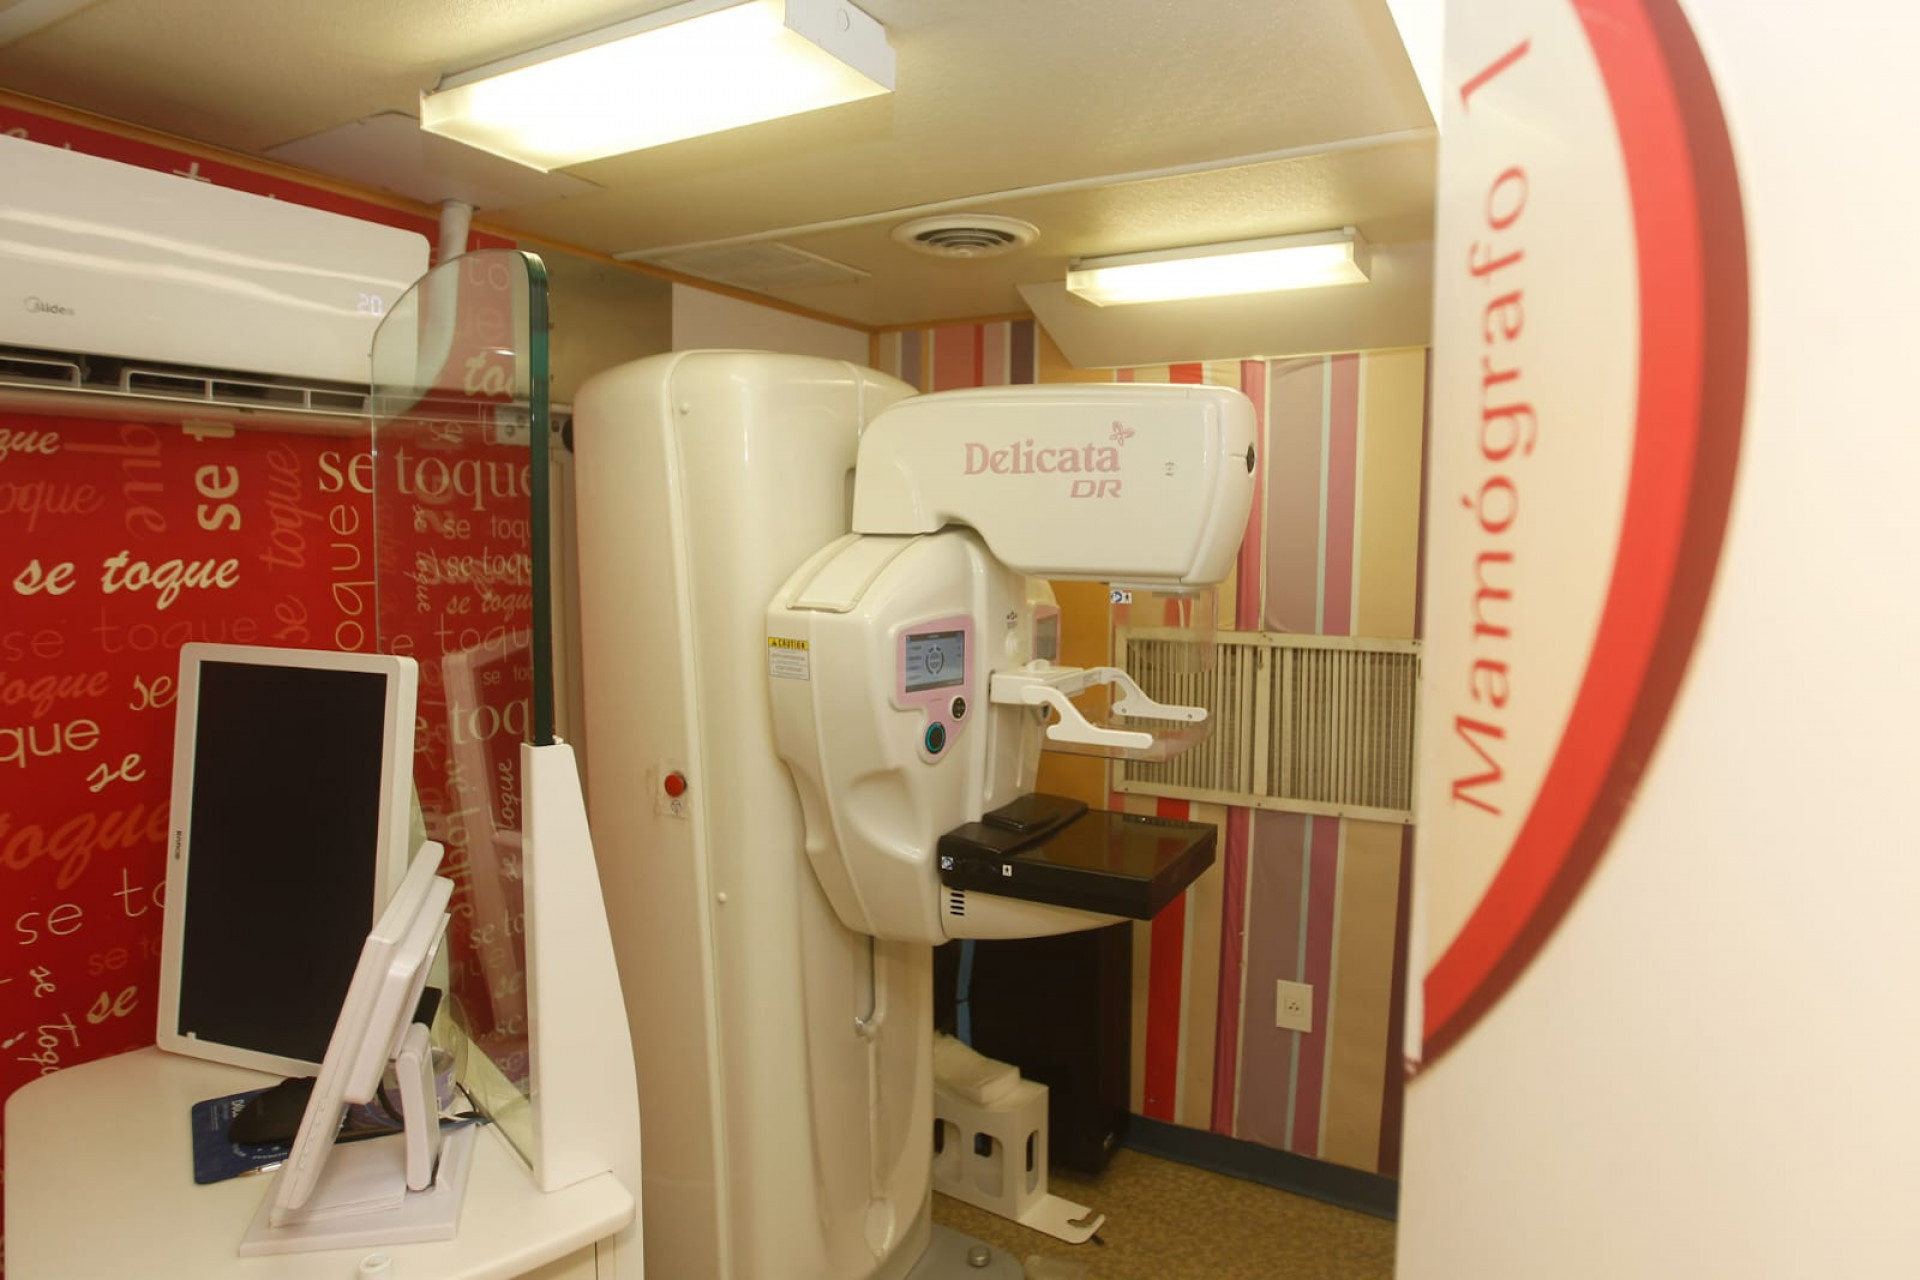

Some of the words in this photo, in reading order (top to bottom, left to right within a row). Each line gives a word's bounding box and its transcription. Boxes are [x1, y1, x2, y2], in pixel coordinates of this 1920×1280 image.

[318, 451, 373, 494] se
[963, 438, 1121, 476] Delicata
[194, 464, 242, 531] se
[1070, 479, 1122, 498] DR
[1451, 166, 1537, 817] Mamógrafo
[12, 559, 77, 596] se
[100, 550, 242, 611] toque
[86, 752, 146, 793] se
[16, 903, 84, 945] se
[86, 985, 139, 1025] se
